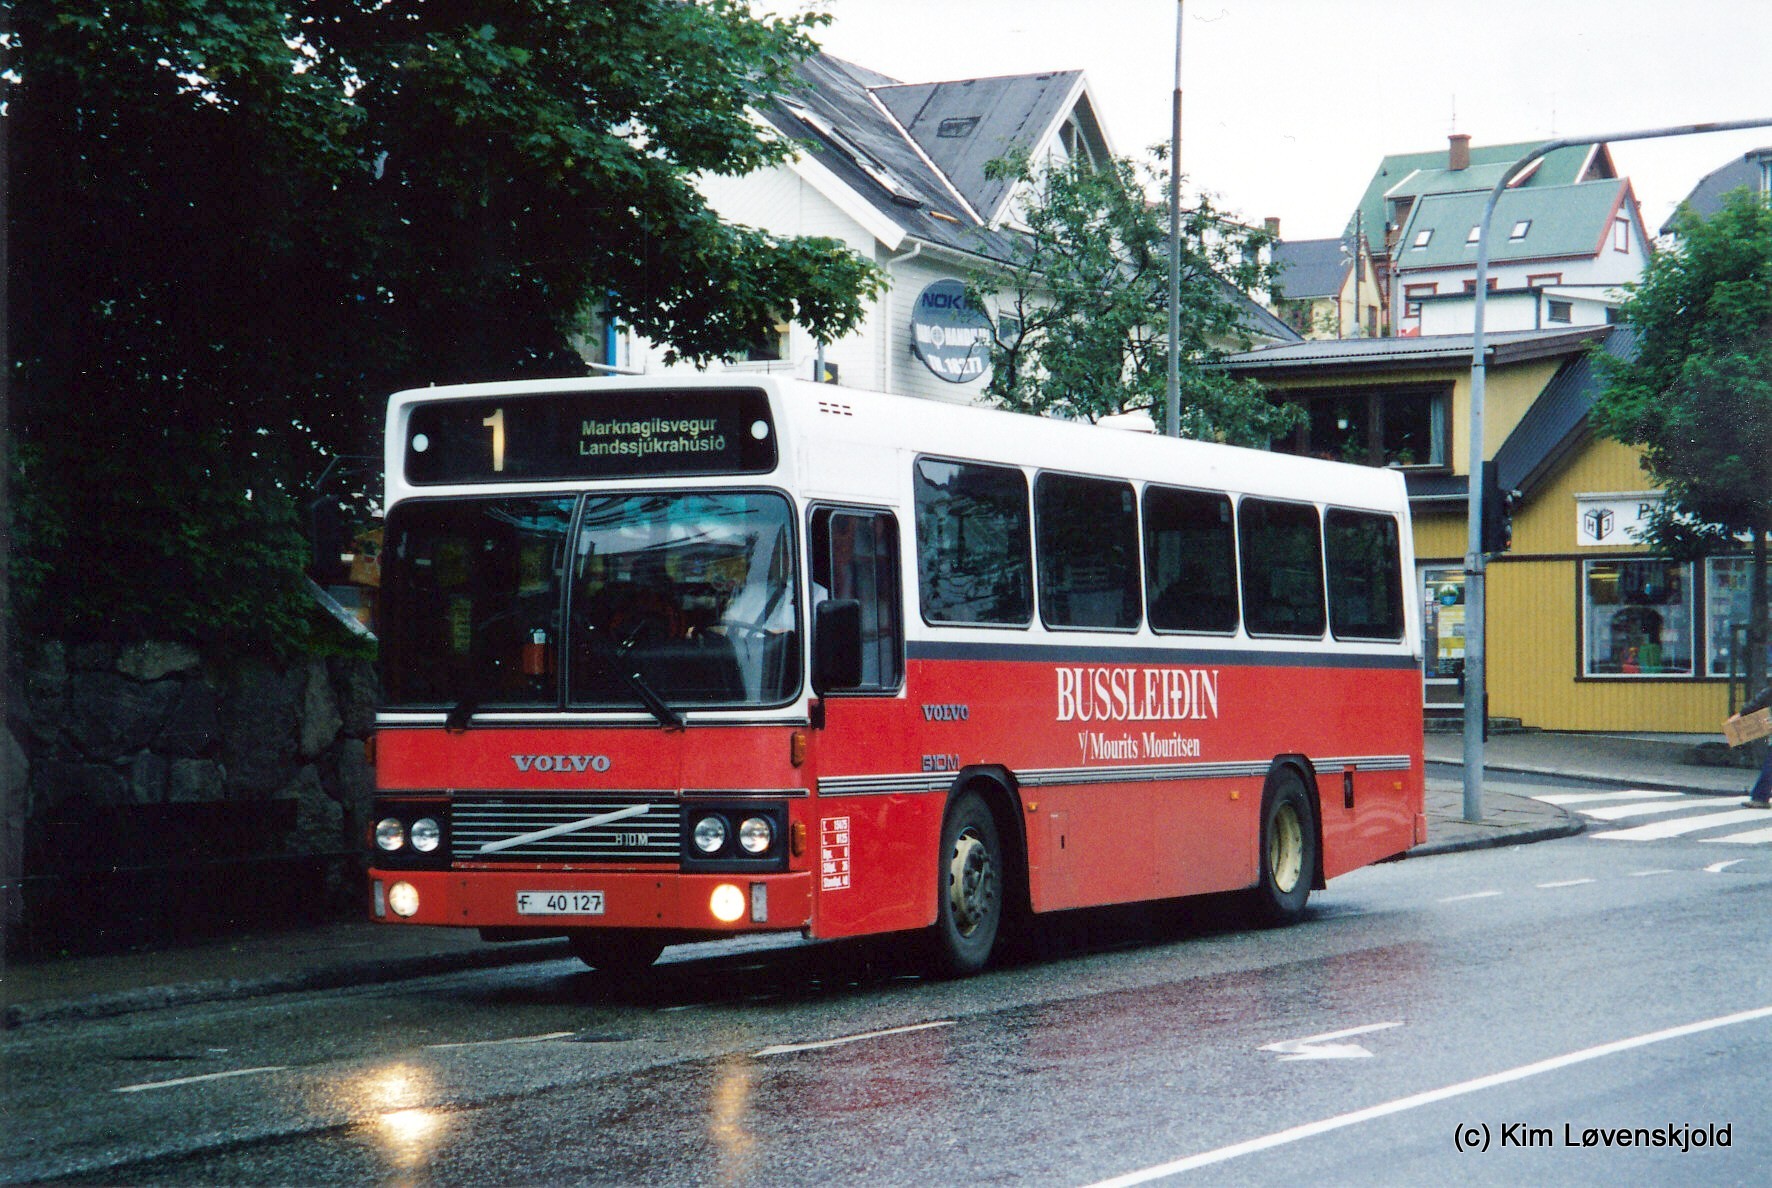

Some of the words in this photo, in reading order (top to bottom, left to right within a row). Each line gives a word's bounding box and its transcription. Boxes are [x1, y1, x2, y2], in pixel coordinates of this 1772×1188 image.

[582, 418, 717, 438] Marknagilsvegur
[482, 408, 505, 472] 1
[580, 435, 725, 457] Landssjúkrahúsið
[1055, 667, 1219, 722] BUSSLEIÐIN
[922, 704, 969, 721] VOLVO
[1090, 732, 1138, 760] Mourits
[1142, 731, 1201, 758] Mouritsen
[511, 755, 612, 773] VOLVO
[615, 832, 649, 847] B10M
[521, 895, 530, 910] F
